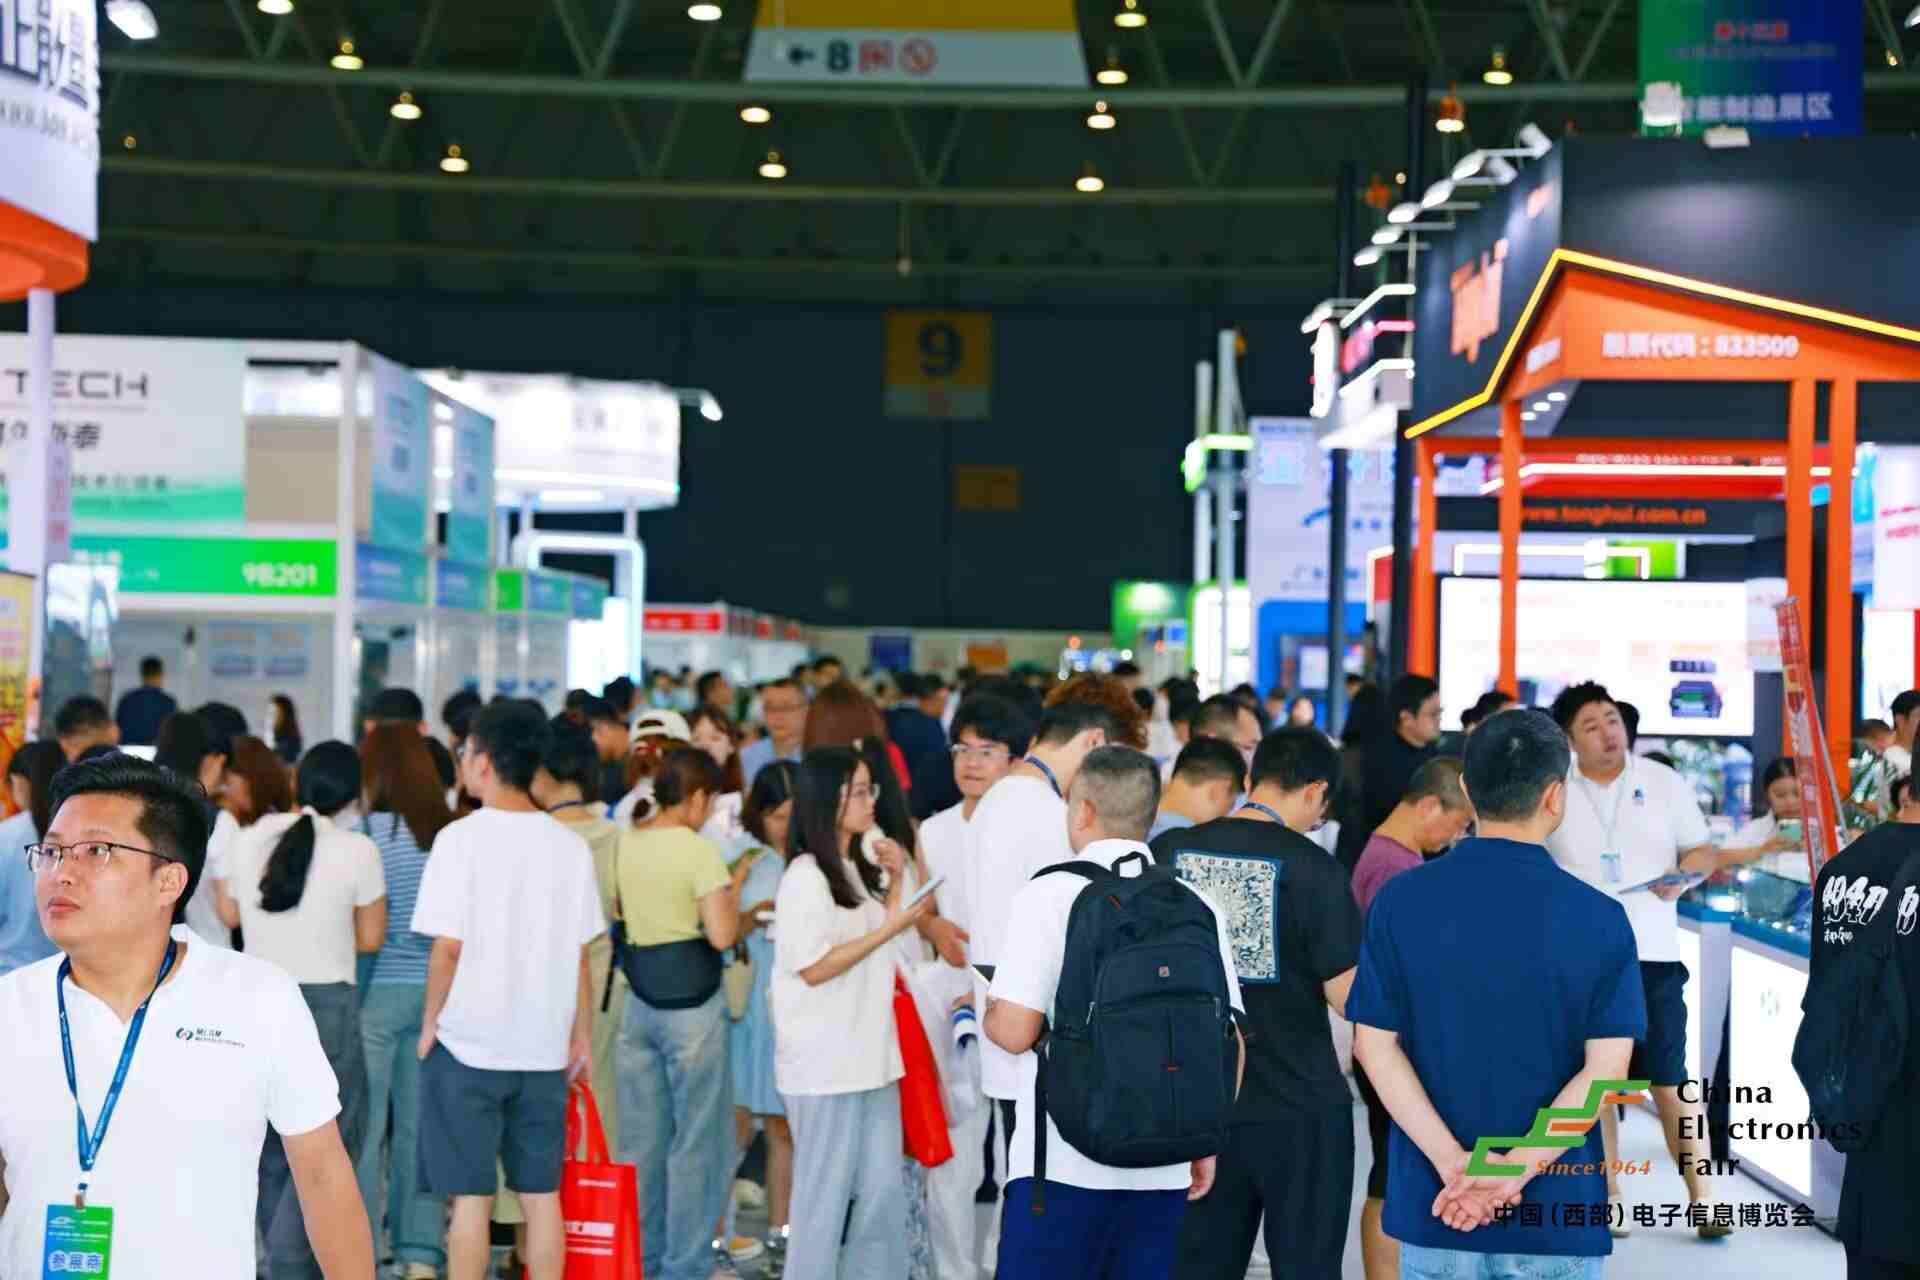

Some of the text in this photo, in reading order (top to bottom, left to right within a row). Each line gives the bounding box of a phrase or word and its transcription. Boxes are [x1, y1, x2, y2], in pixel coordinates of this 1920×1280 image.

[827, 41, 850, 73] 8
[919, 318, 962, 377] 9
[241, 562, 318, 588] 9B201
[48, 1251, 103, 1273] 参展商
